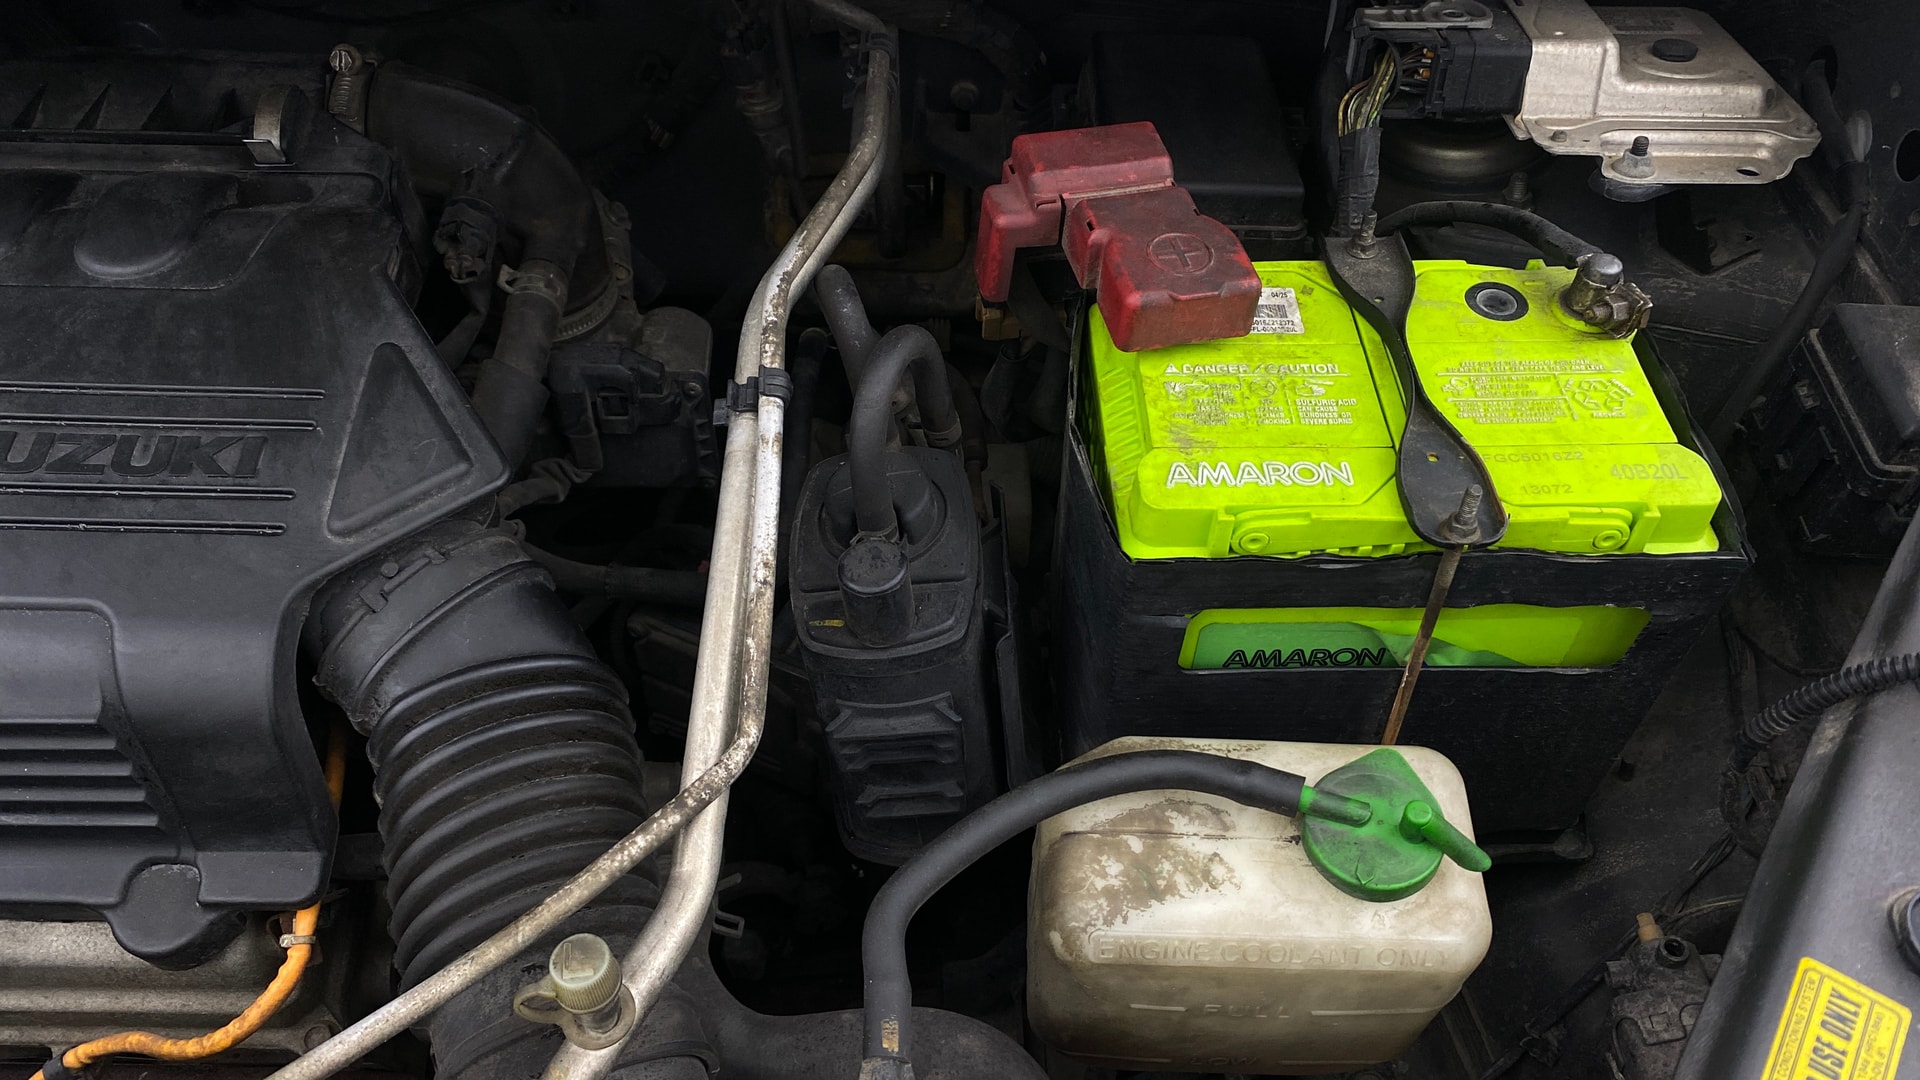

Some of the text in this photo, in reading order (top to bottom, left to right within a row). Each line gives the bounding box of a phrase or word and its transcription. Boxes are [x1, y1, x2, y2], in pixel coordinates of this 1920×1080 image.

[1182, 362, 1250, 375] DANGER
[1266, 362, 1340, 374] CAUTION
[1338, 398, 1357, 406] ACID
[1166, 460, 1355, 488] AMARON
[1610, 463, 1689, 481] 40B20L
[1520, 483, 1574, 495] 13072
[1222, 647, 1387, 668] AMARON
[1097, 937, 1450, 969] ENGINE COOLANT ONLY
[1798, 976, 1817, 1013] SYSTEM
[1202, 1003, 1292, 1020] FULL
[1807, 985, 1863, 1080] USE ONLY
